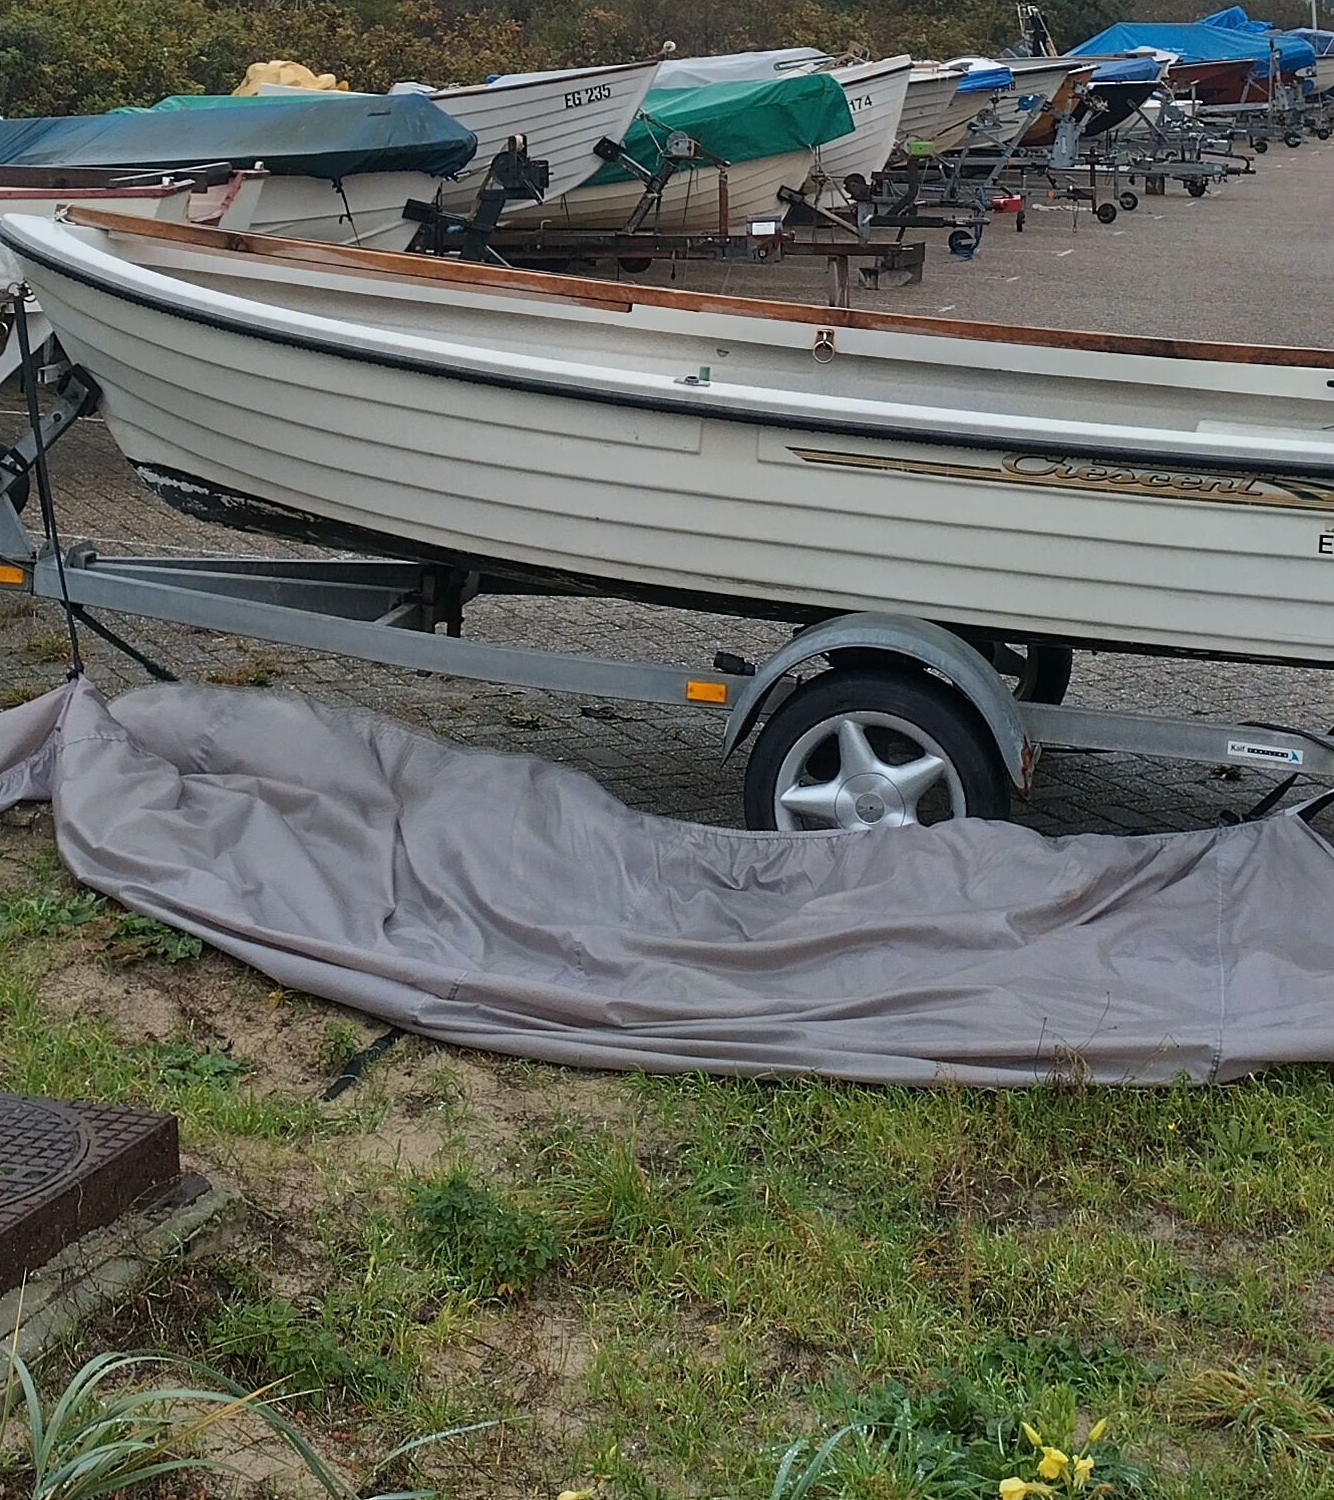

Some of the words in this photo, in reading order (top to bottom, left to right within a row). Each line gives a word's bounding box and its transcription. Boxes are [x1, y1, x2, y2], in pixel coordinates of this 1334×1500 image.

[564, 91, 582, 109] EG
[585, 84, 611, 103] 235
[849, 95, 873, 112] 174
[1001, 452, 1273, 496] Crescent
[1230, 744, 1246, 752] Kalf
